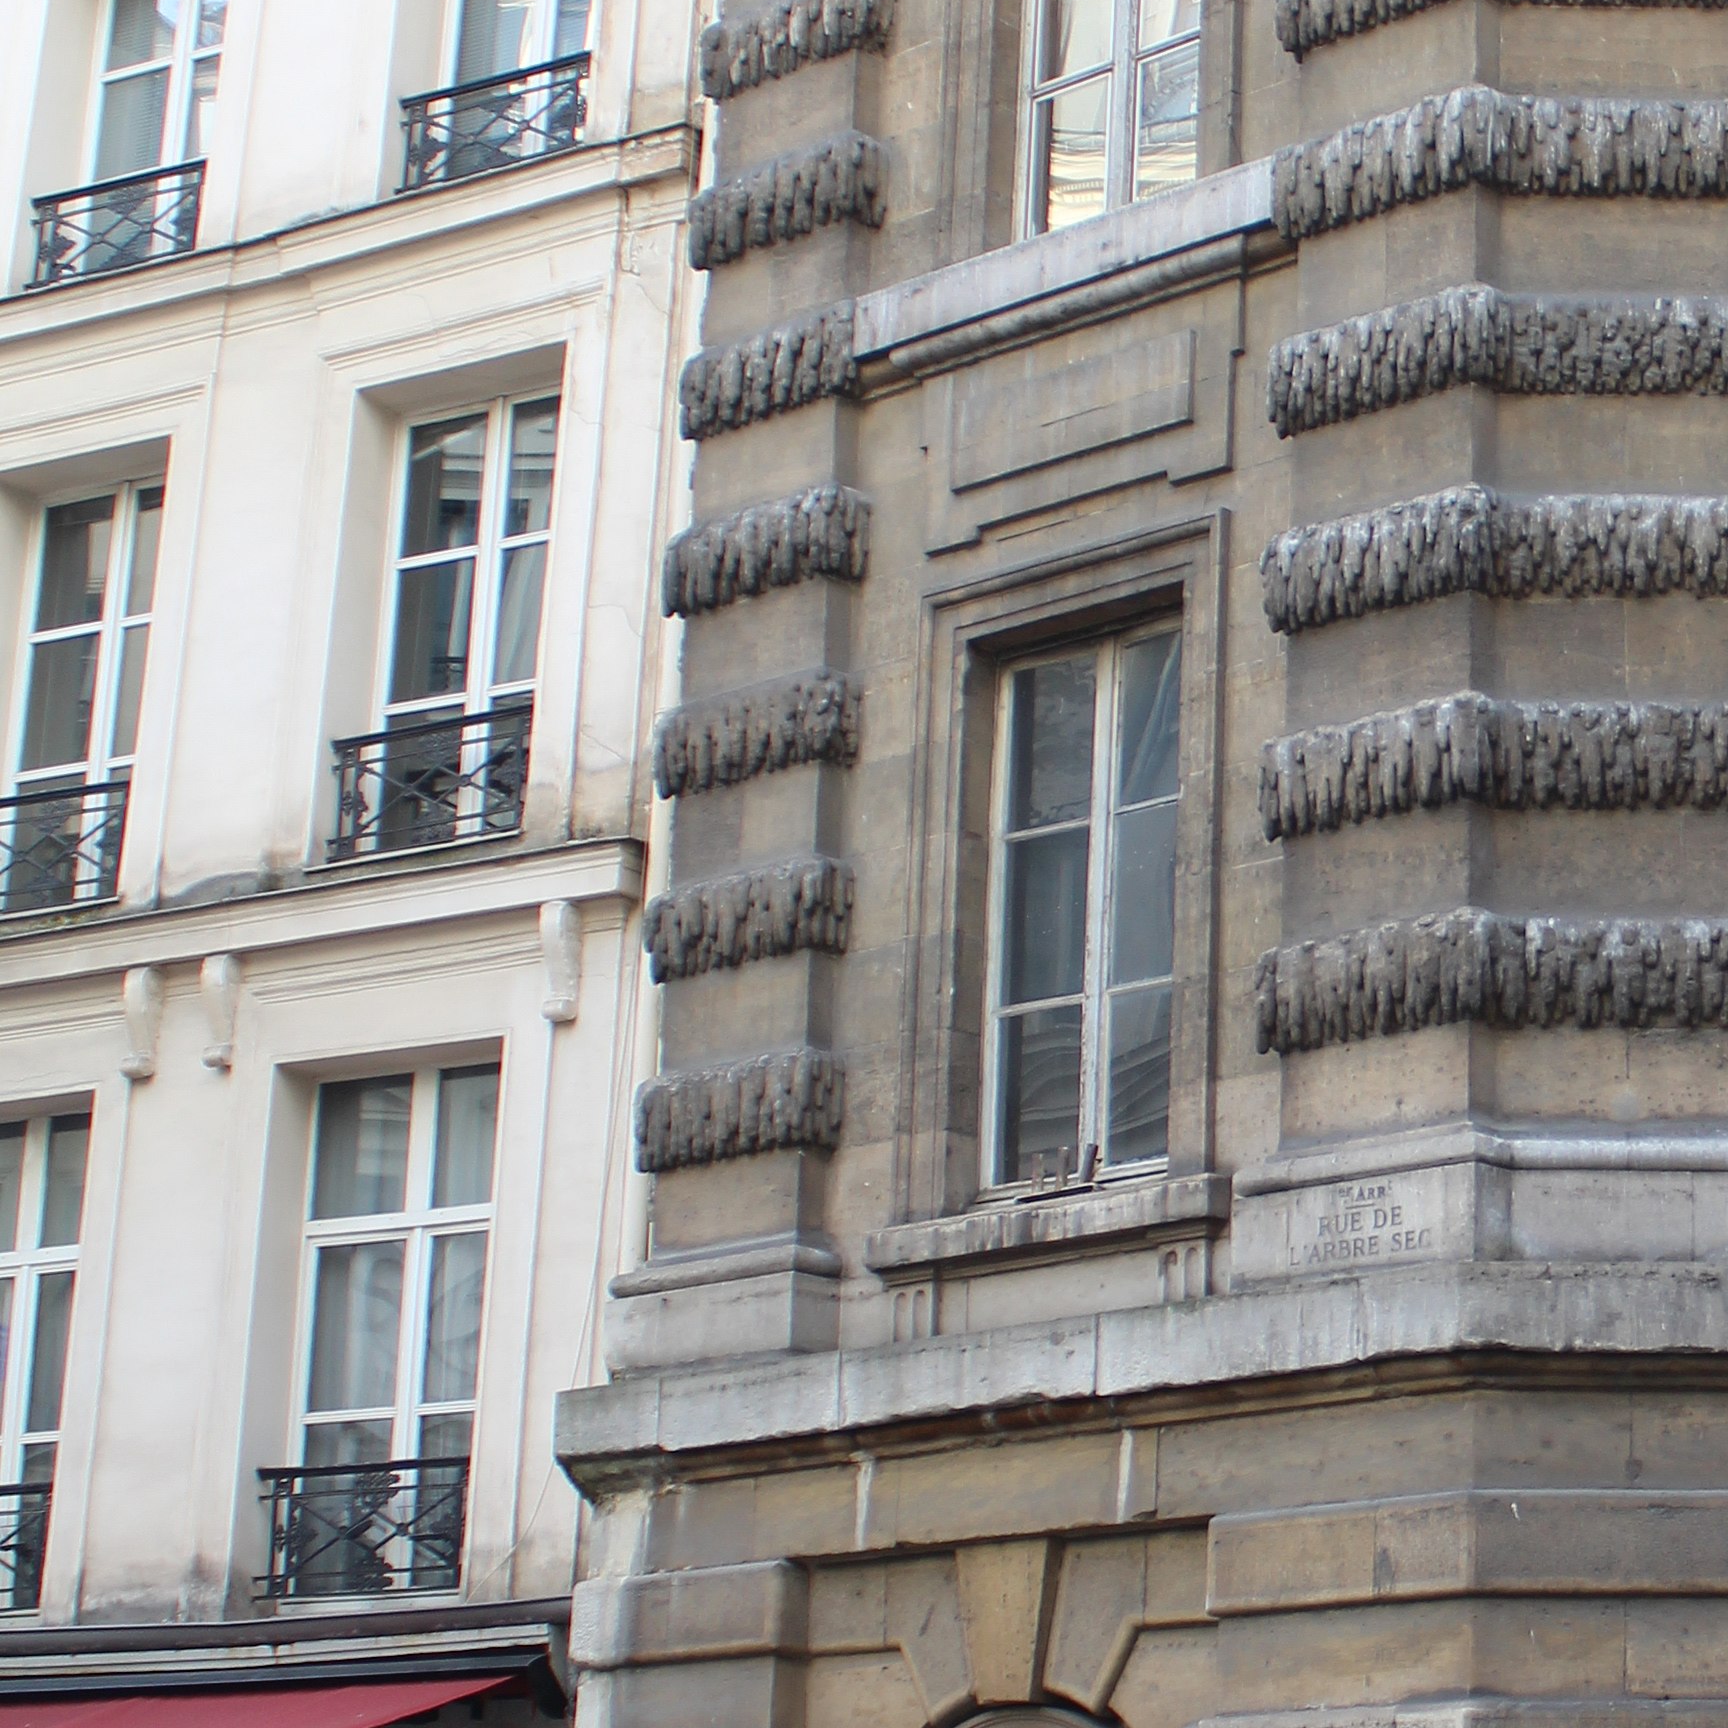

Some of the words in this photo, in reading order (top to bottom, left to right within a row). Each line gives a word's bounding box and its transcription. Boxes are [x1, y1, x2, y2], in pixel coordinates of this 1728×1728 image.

[1318, 1212, 1363, 1237] RUE
[1373, 1206, 1402, 1229] DE
[1290, 1235, 1379, 1266] L'ARBRE
[1390, 1229, 1432, 1253] SEC
